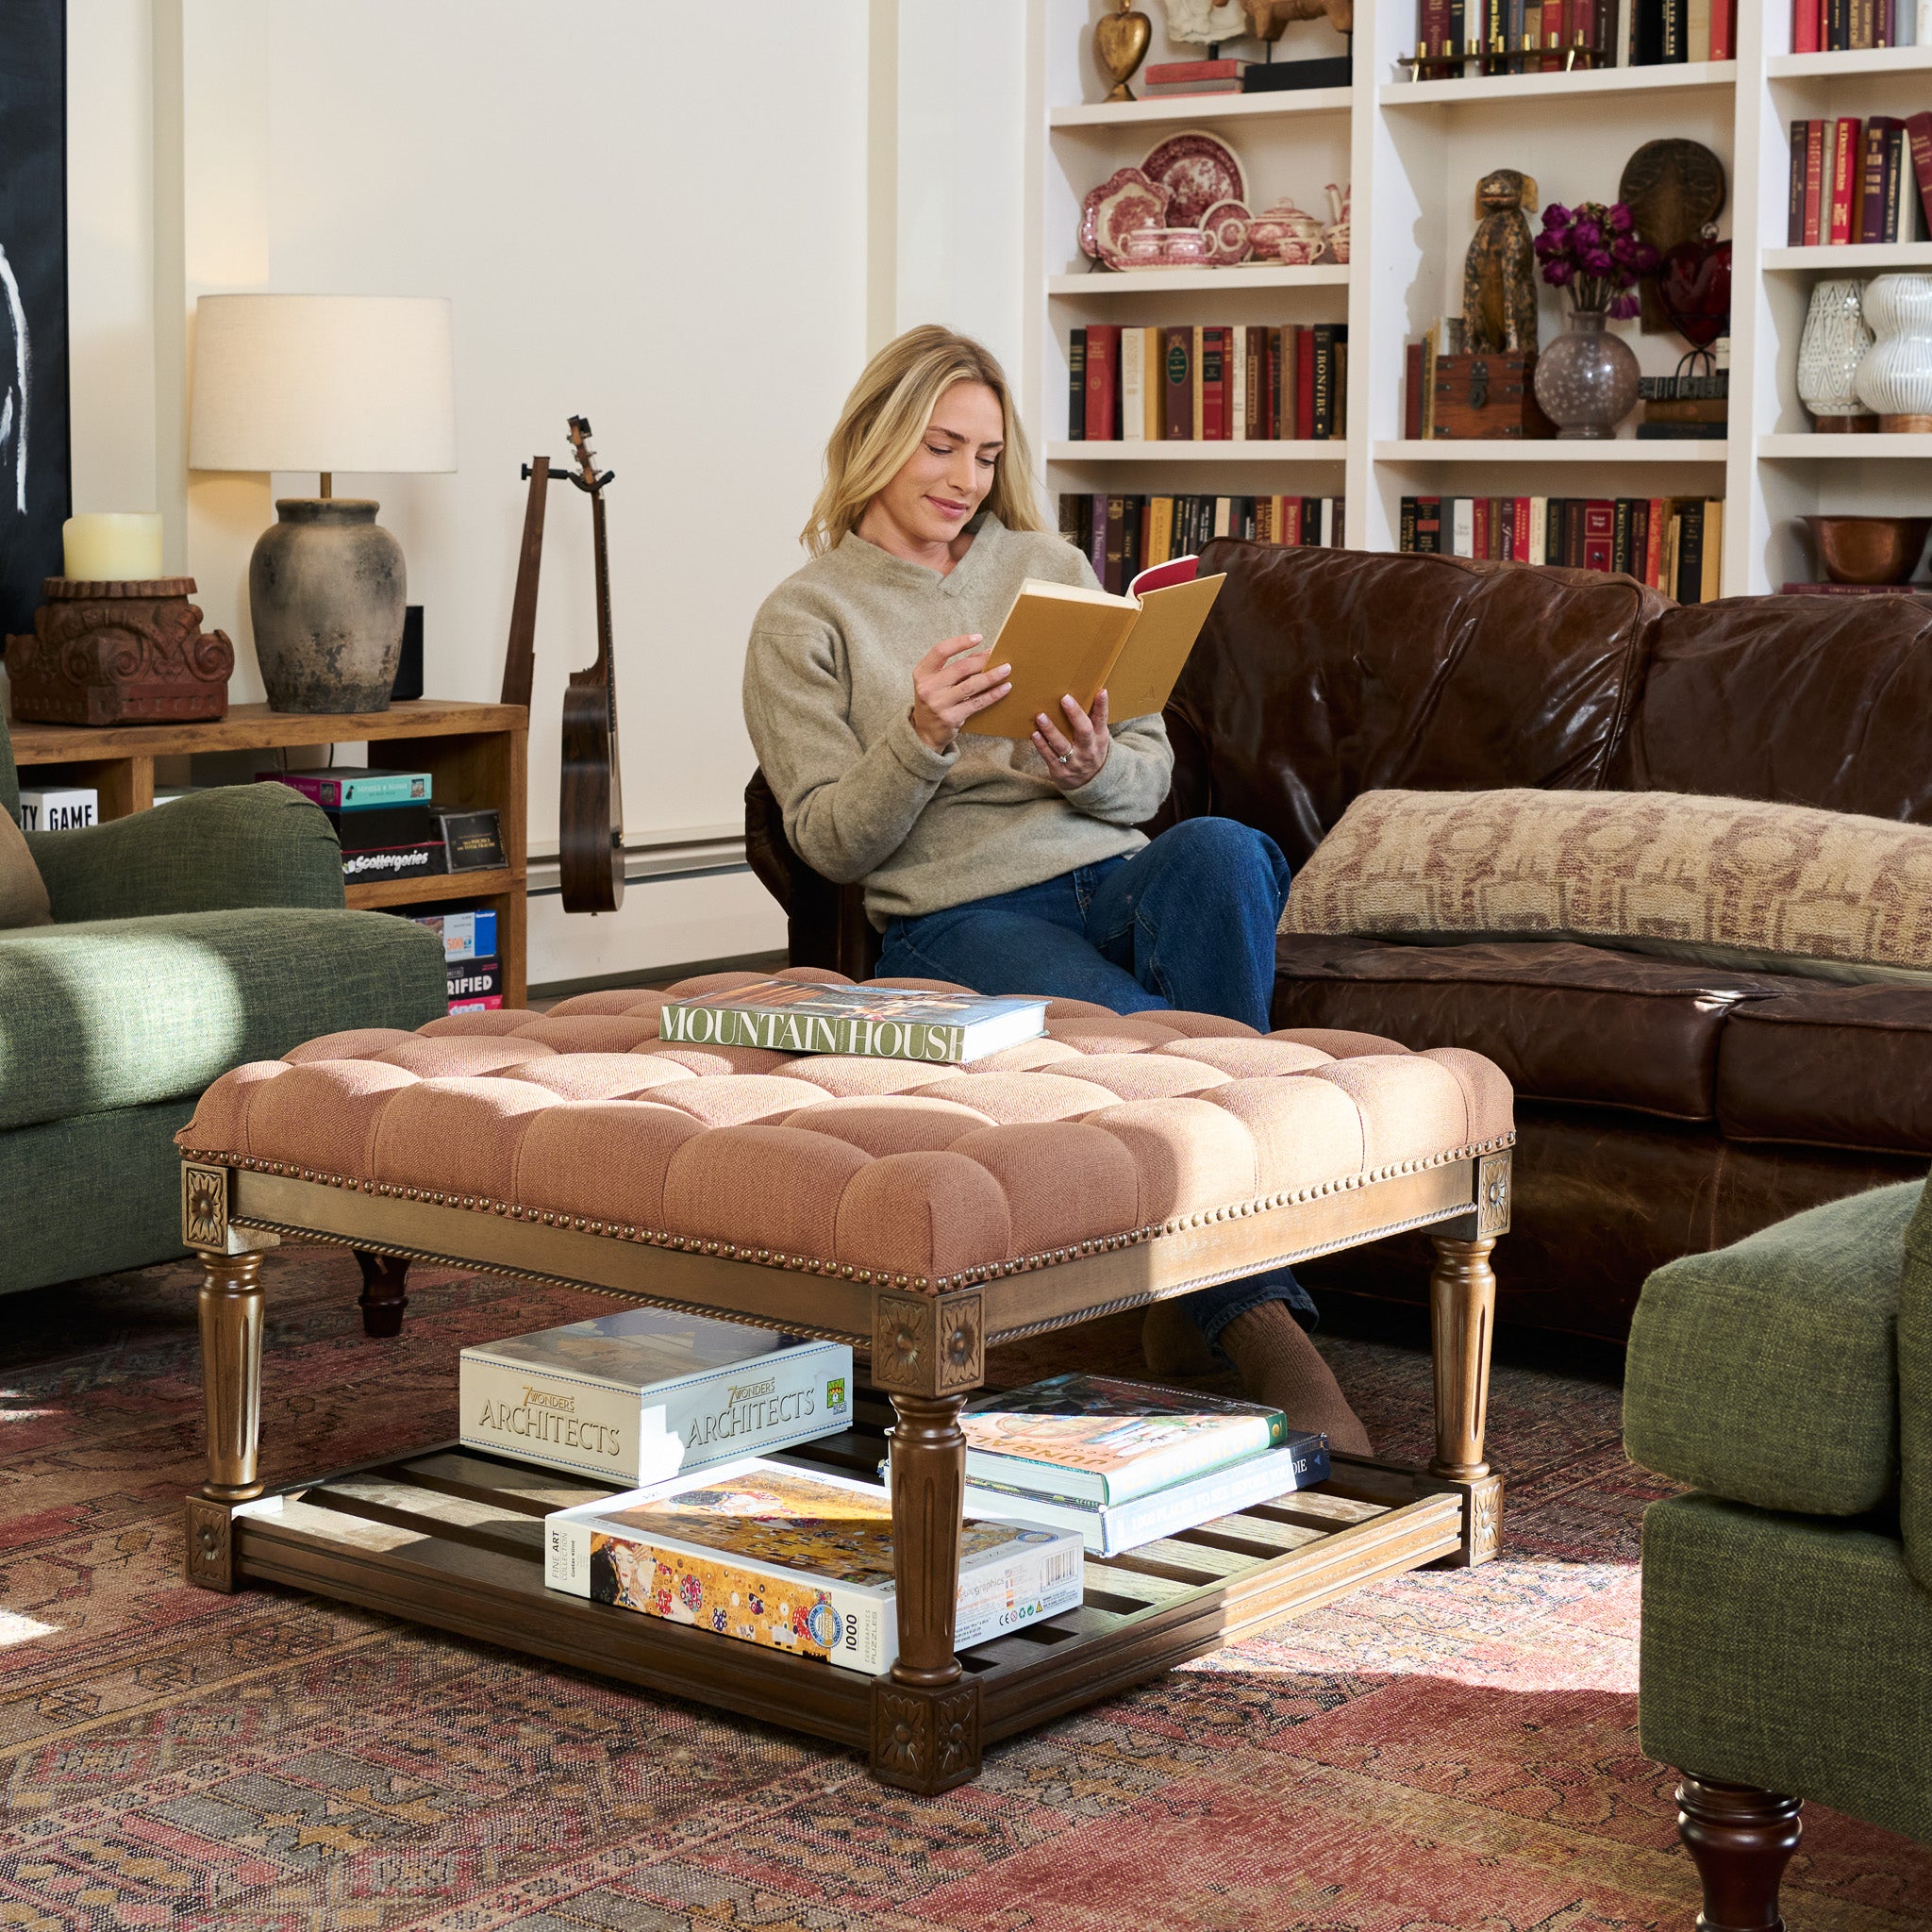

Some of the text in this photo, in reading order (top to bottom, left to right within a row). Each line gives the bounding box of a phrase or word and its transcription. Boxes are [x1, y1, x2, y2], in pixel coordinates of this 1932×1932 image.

[1316, 349, 1327, 416] IRONFIRE
[20, 805, 38, 830] TY
[355, 850, 429, 873] Scattergories
[446, 936, 463, 951] 500
[446, 974, 492, 995] RIFIED
[658, 1006, 841, 1053] MOUNTAIN
[522, 1387, 575, 1411] 7 WONDERS
[726, 1381, 775, 1407] 7 WONDERS
[478, 1399, 621, 1457] ARCHITECTS
[686, 1389, 815, 1449] ARCHITECTS
[966, 1432, 1108, 1466] JUNGAL
[809, 1607, 820, 1639] MUSEUM
[845, 1614, 858, 1651] 1000
